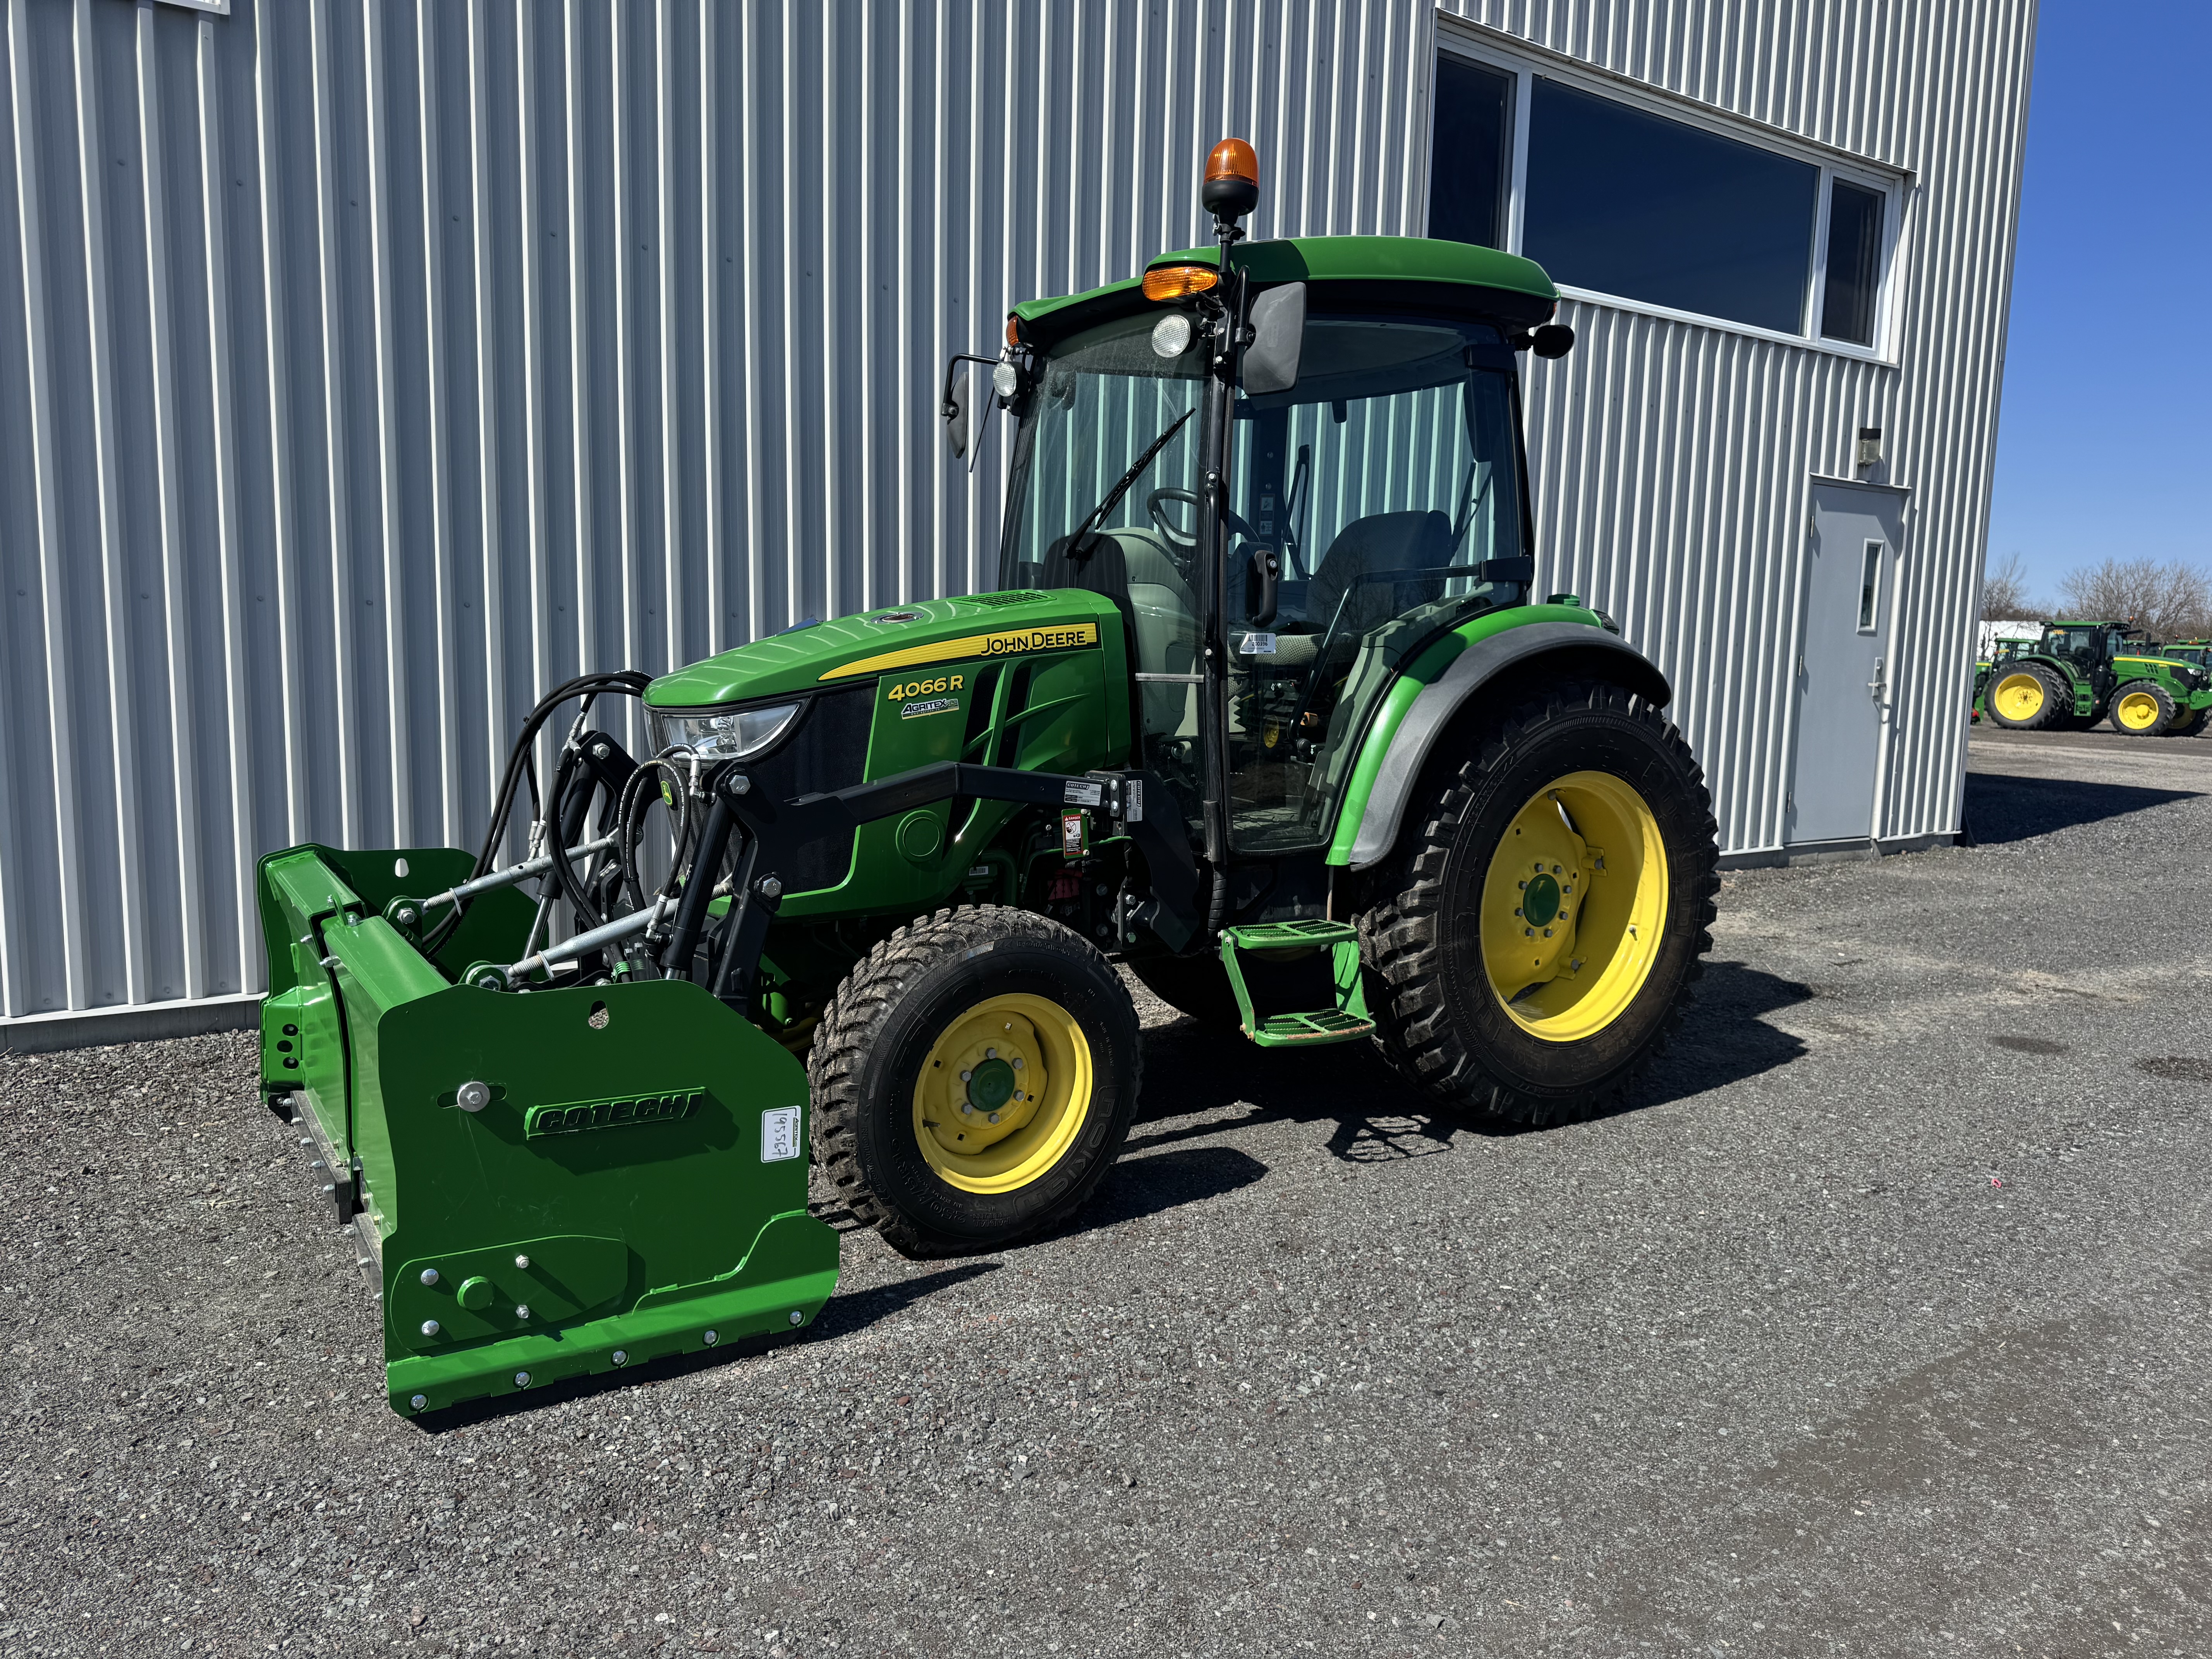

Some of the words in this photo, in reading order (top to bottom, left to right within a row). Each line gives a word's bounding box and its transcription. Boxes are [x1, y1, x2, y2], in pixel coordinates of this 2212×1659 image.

[981, 635, 1029, 654] JOHN
[1032, 631, 1085, 648] DEERE
[903, 699, 946, 713] AGRITEX
[1017, 941, 1070, 956] ROTATION
[537, 1094, 681, 1128] COTECH
[772, 1113, 788, 1157] 195567
[862, 1126, 881, 1187] ROTATION
[973, 1216, 1011, 1227] RADIAL
